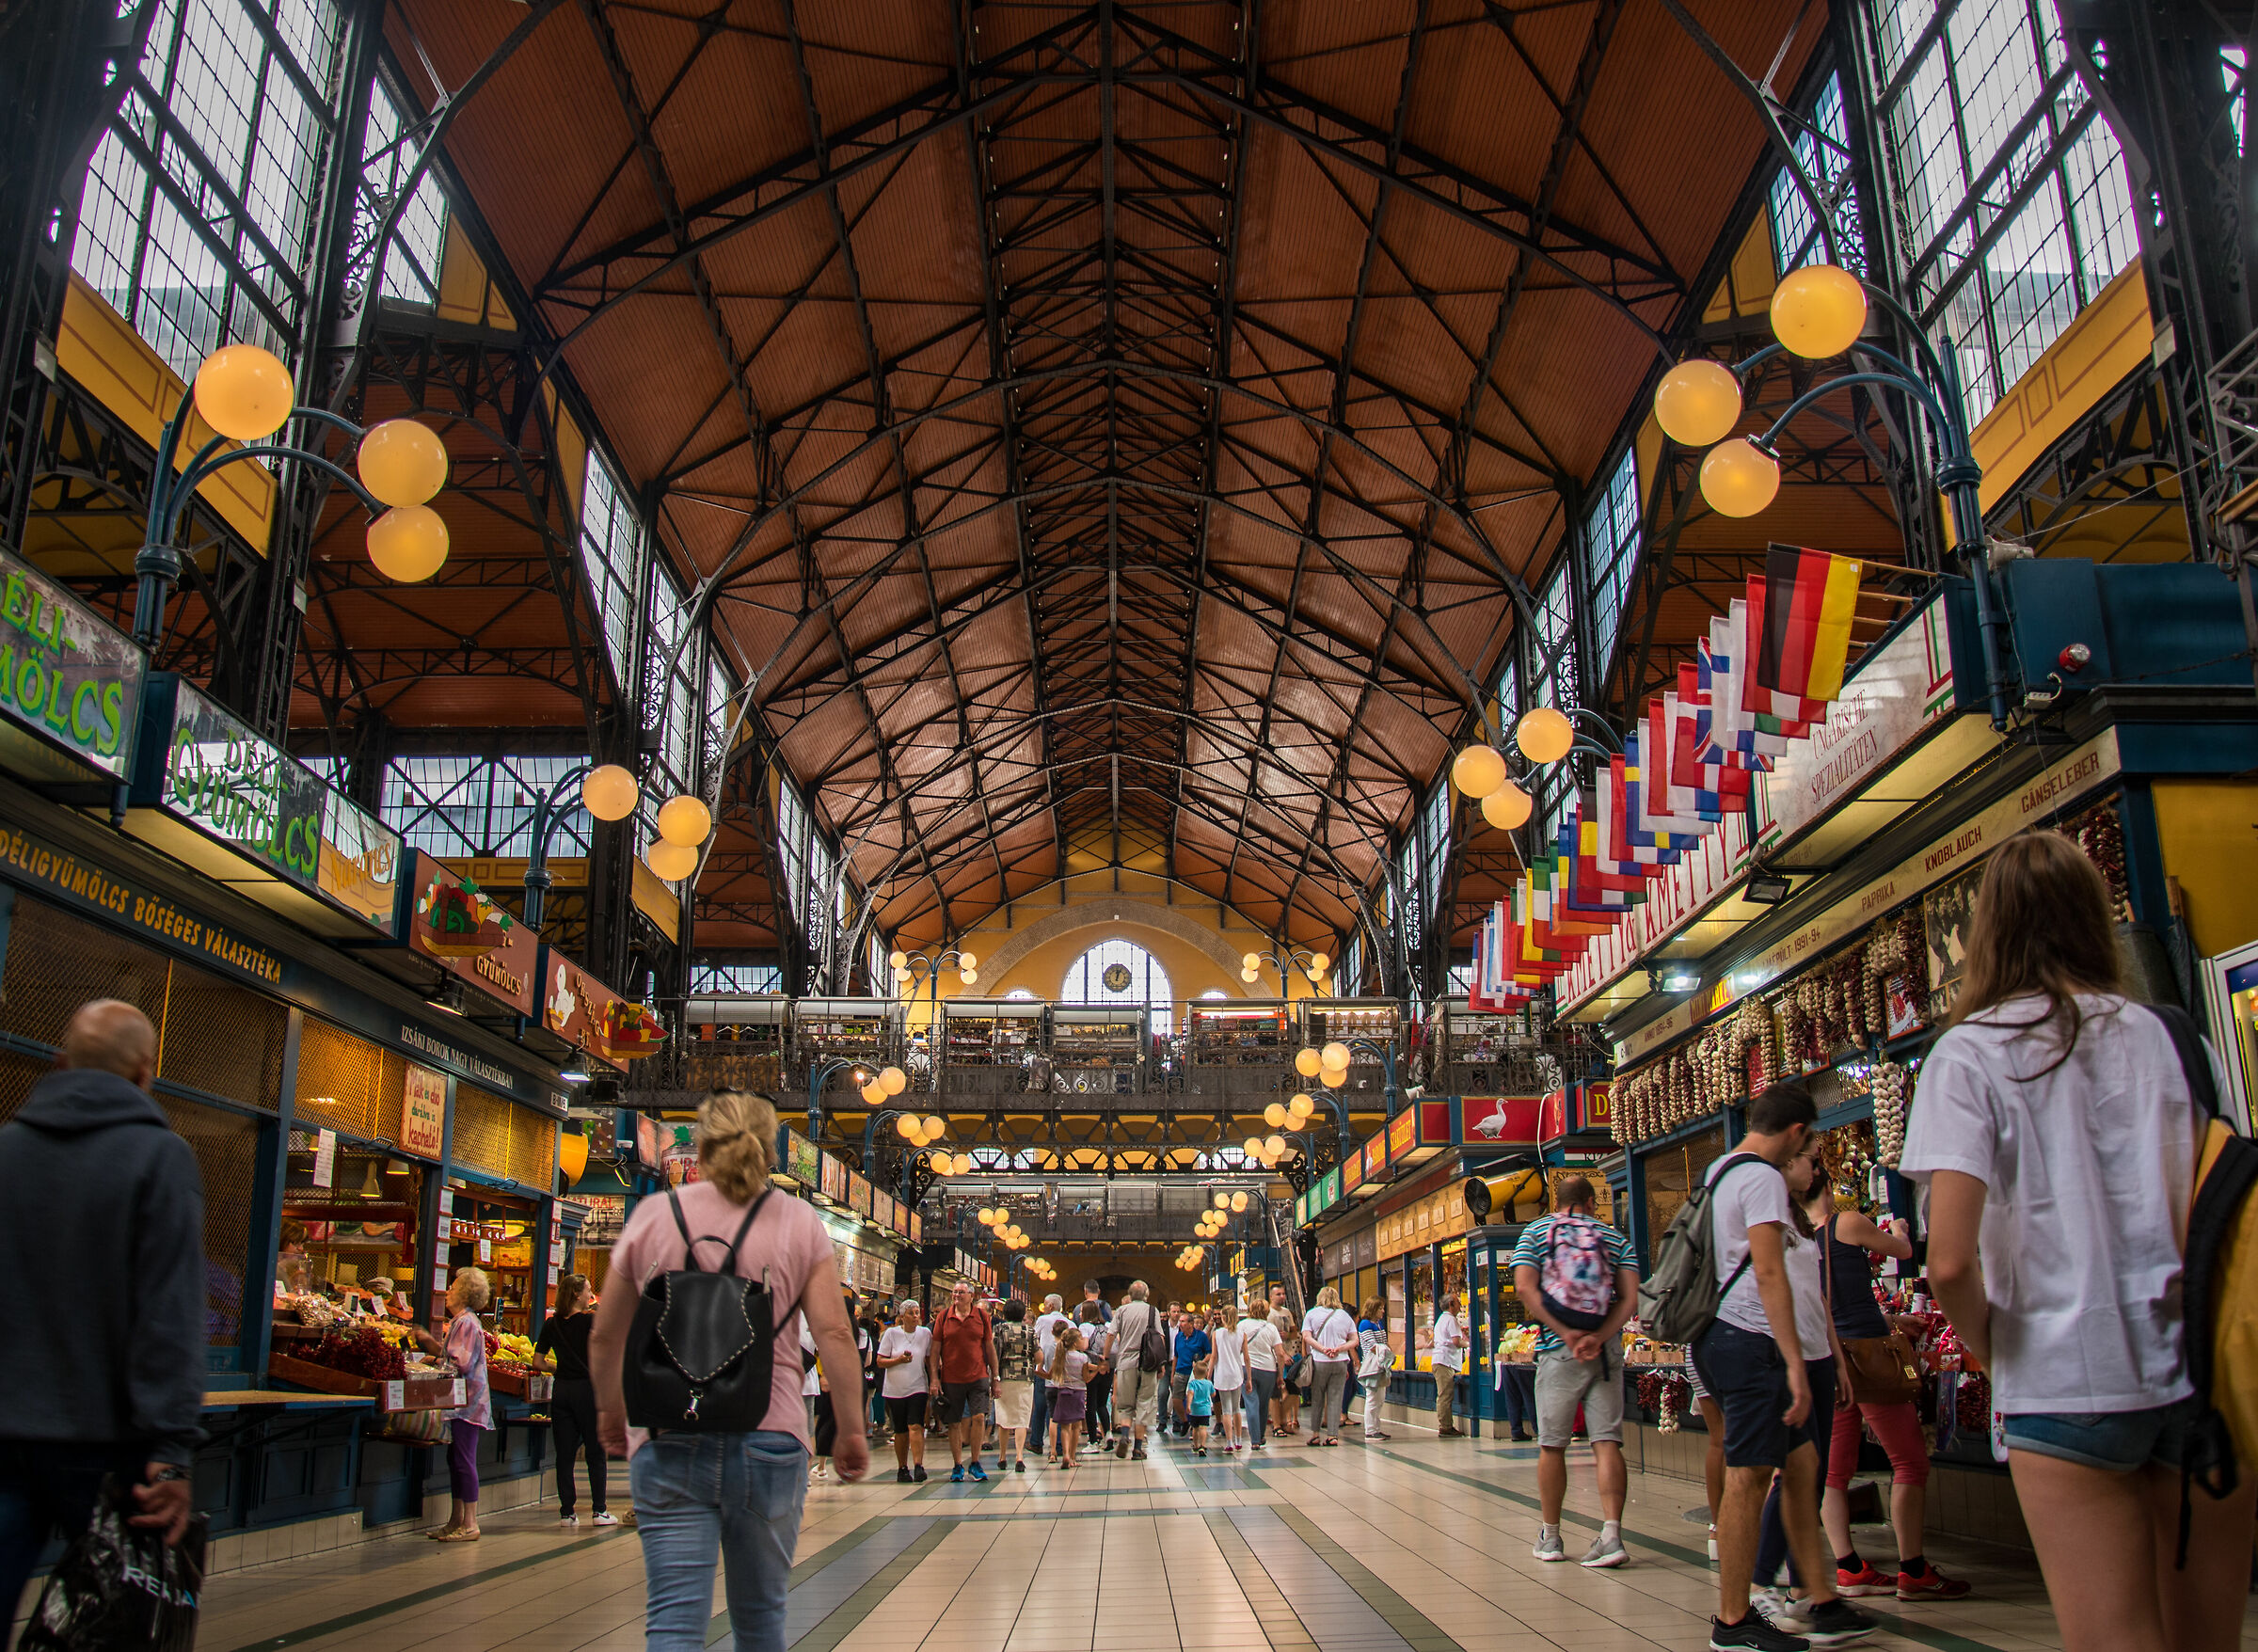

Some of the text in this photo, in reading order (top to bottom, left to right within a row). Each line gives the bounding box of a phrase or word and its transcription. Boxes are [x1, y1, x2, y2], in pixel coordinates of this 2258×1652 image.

[0, 569, 77, 656] ÉLI-
[1812, 689, 1868, 759] UNGARISCHE
[226, 729, 290, 802] DÉLI-
[1811, 725, 1877, 804] SPEZIALITÄTEN
[2021, 751, 2100, 814] GÄNSELEBER
[172, 728, 319, 879] GYÜMÖLCS
[1925, 825, 1982, 873] KNOBLAUCH
[0, 829, 281, 985] DÉLIGYÜMÖLCS BŐSÉGES VÁLASZTÉKA
[1861, 881, 1896, 913] PAPRIKA
[1793, 926, 1821, 951] 1991-94
[477, 954, 521, 994] GYÜMÖLCS
[401, 1025, 514, 1090] IZSÁKI BOROK NAGY VÁLASZTÉKBAN
